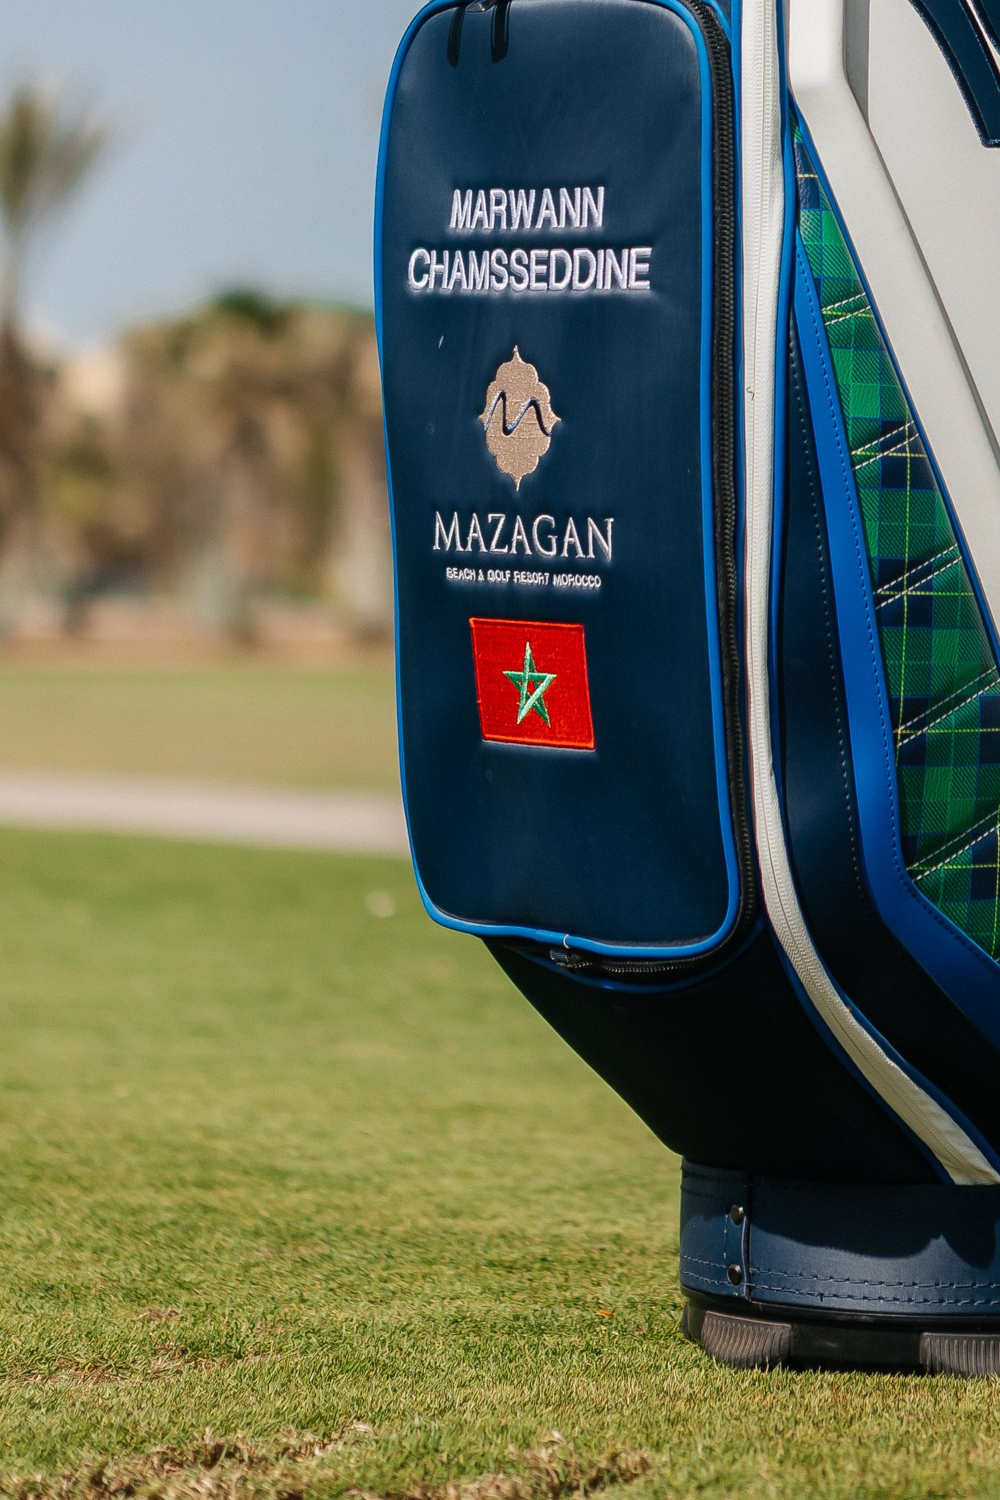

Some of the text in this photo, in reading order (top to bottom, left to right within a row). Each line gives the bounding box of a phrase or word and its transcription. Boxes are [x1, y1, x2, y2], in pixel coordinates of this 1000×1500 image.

[449, 186, 605, 230] MARWANN
[407, 247, 653, 291] CHAMSSEDDINE
[432, 511, 615, 562] MAZAGAN
[446, 567, 602, 589] BEACH & GOLF RESORT MOROCCO
